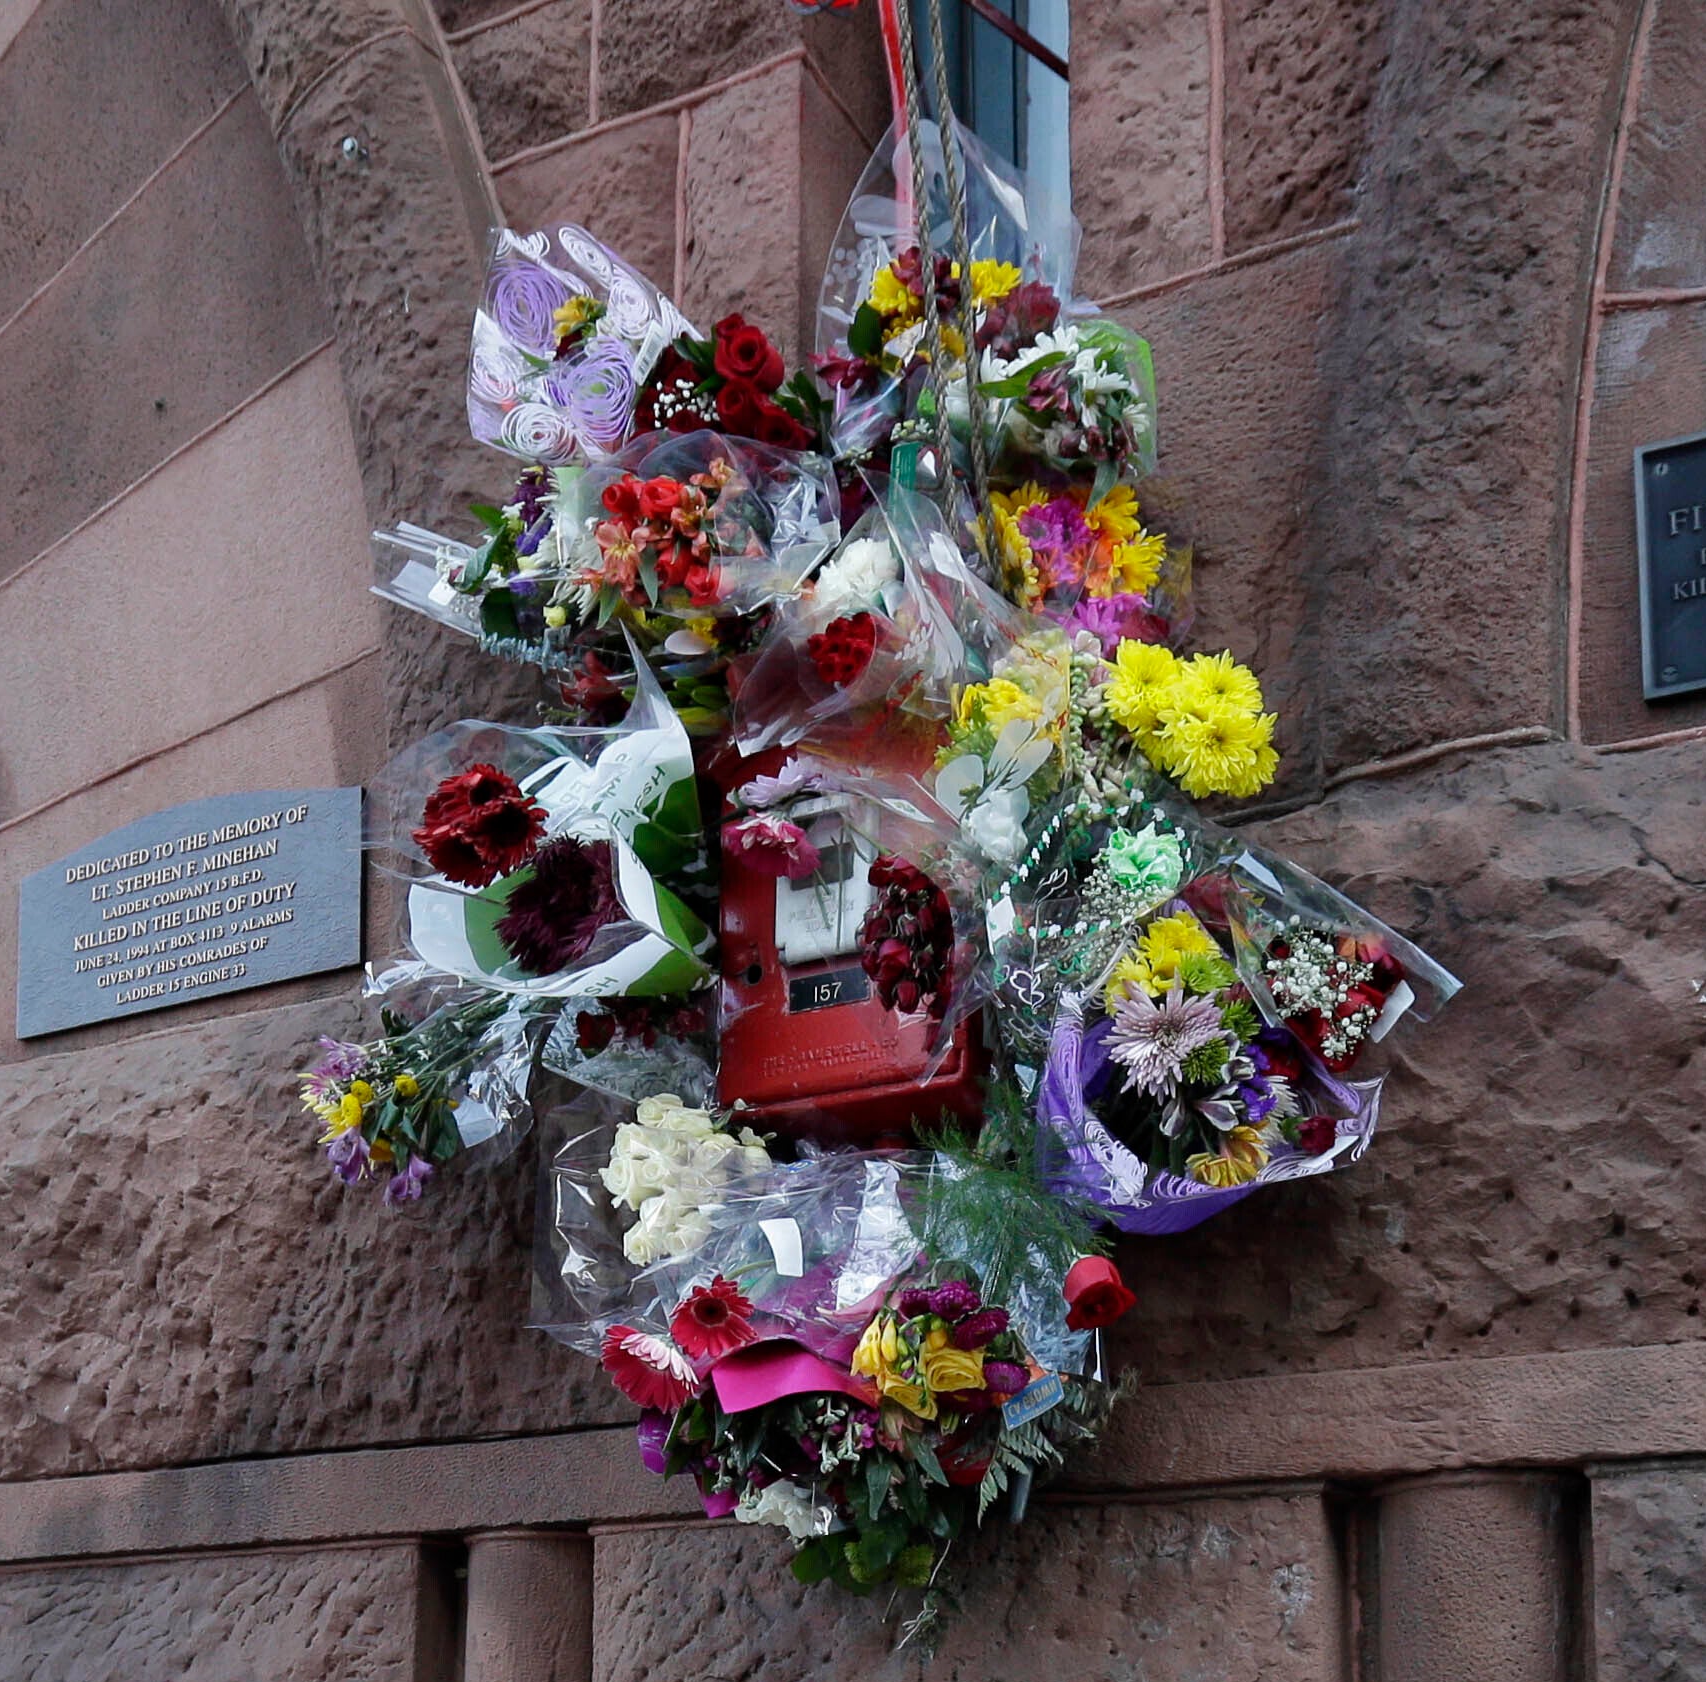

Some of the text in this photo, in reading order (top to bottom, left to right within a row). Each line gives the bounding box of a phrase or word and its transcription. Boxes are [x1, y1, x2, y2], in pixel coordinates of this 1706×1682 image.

[66, 805, 308, 884] DEDICATED TO THE MEMORY OF
[91, 839, 278, 901] LT. STEPHEN F. MINEHAN
[74, 882, 296, 951] KILLED IN THE LINE OF DUTY
[103, 869, 265, 920] LADDER COMPANY 15 B.F.D.
[75, 909, 293, 973] JUNE 24, 1994 AT BOX 4113 9 ALARMS
[98, 936, 268, 987] GIVEN BY HIS COMRADES OF
[116, 964, 245, 1004] LADDER 15 ENGINE 33
[814, 981, 842, 1002] 157
